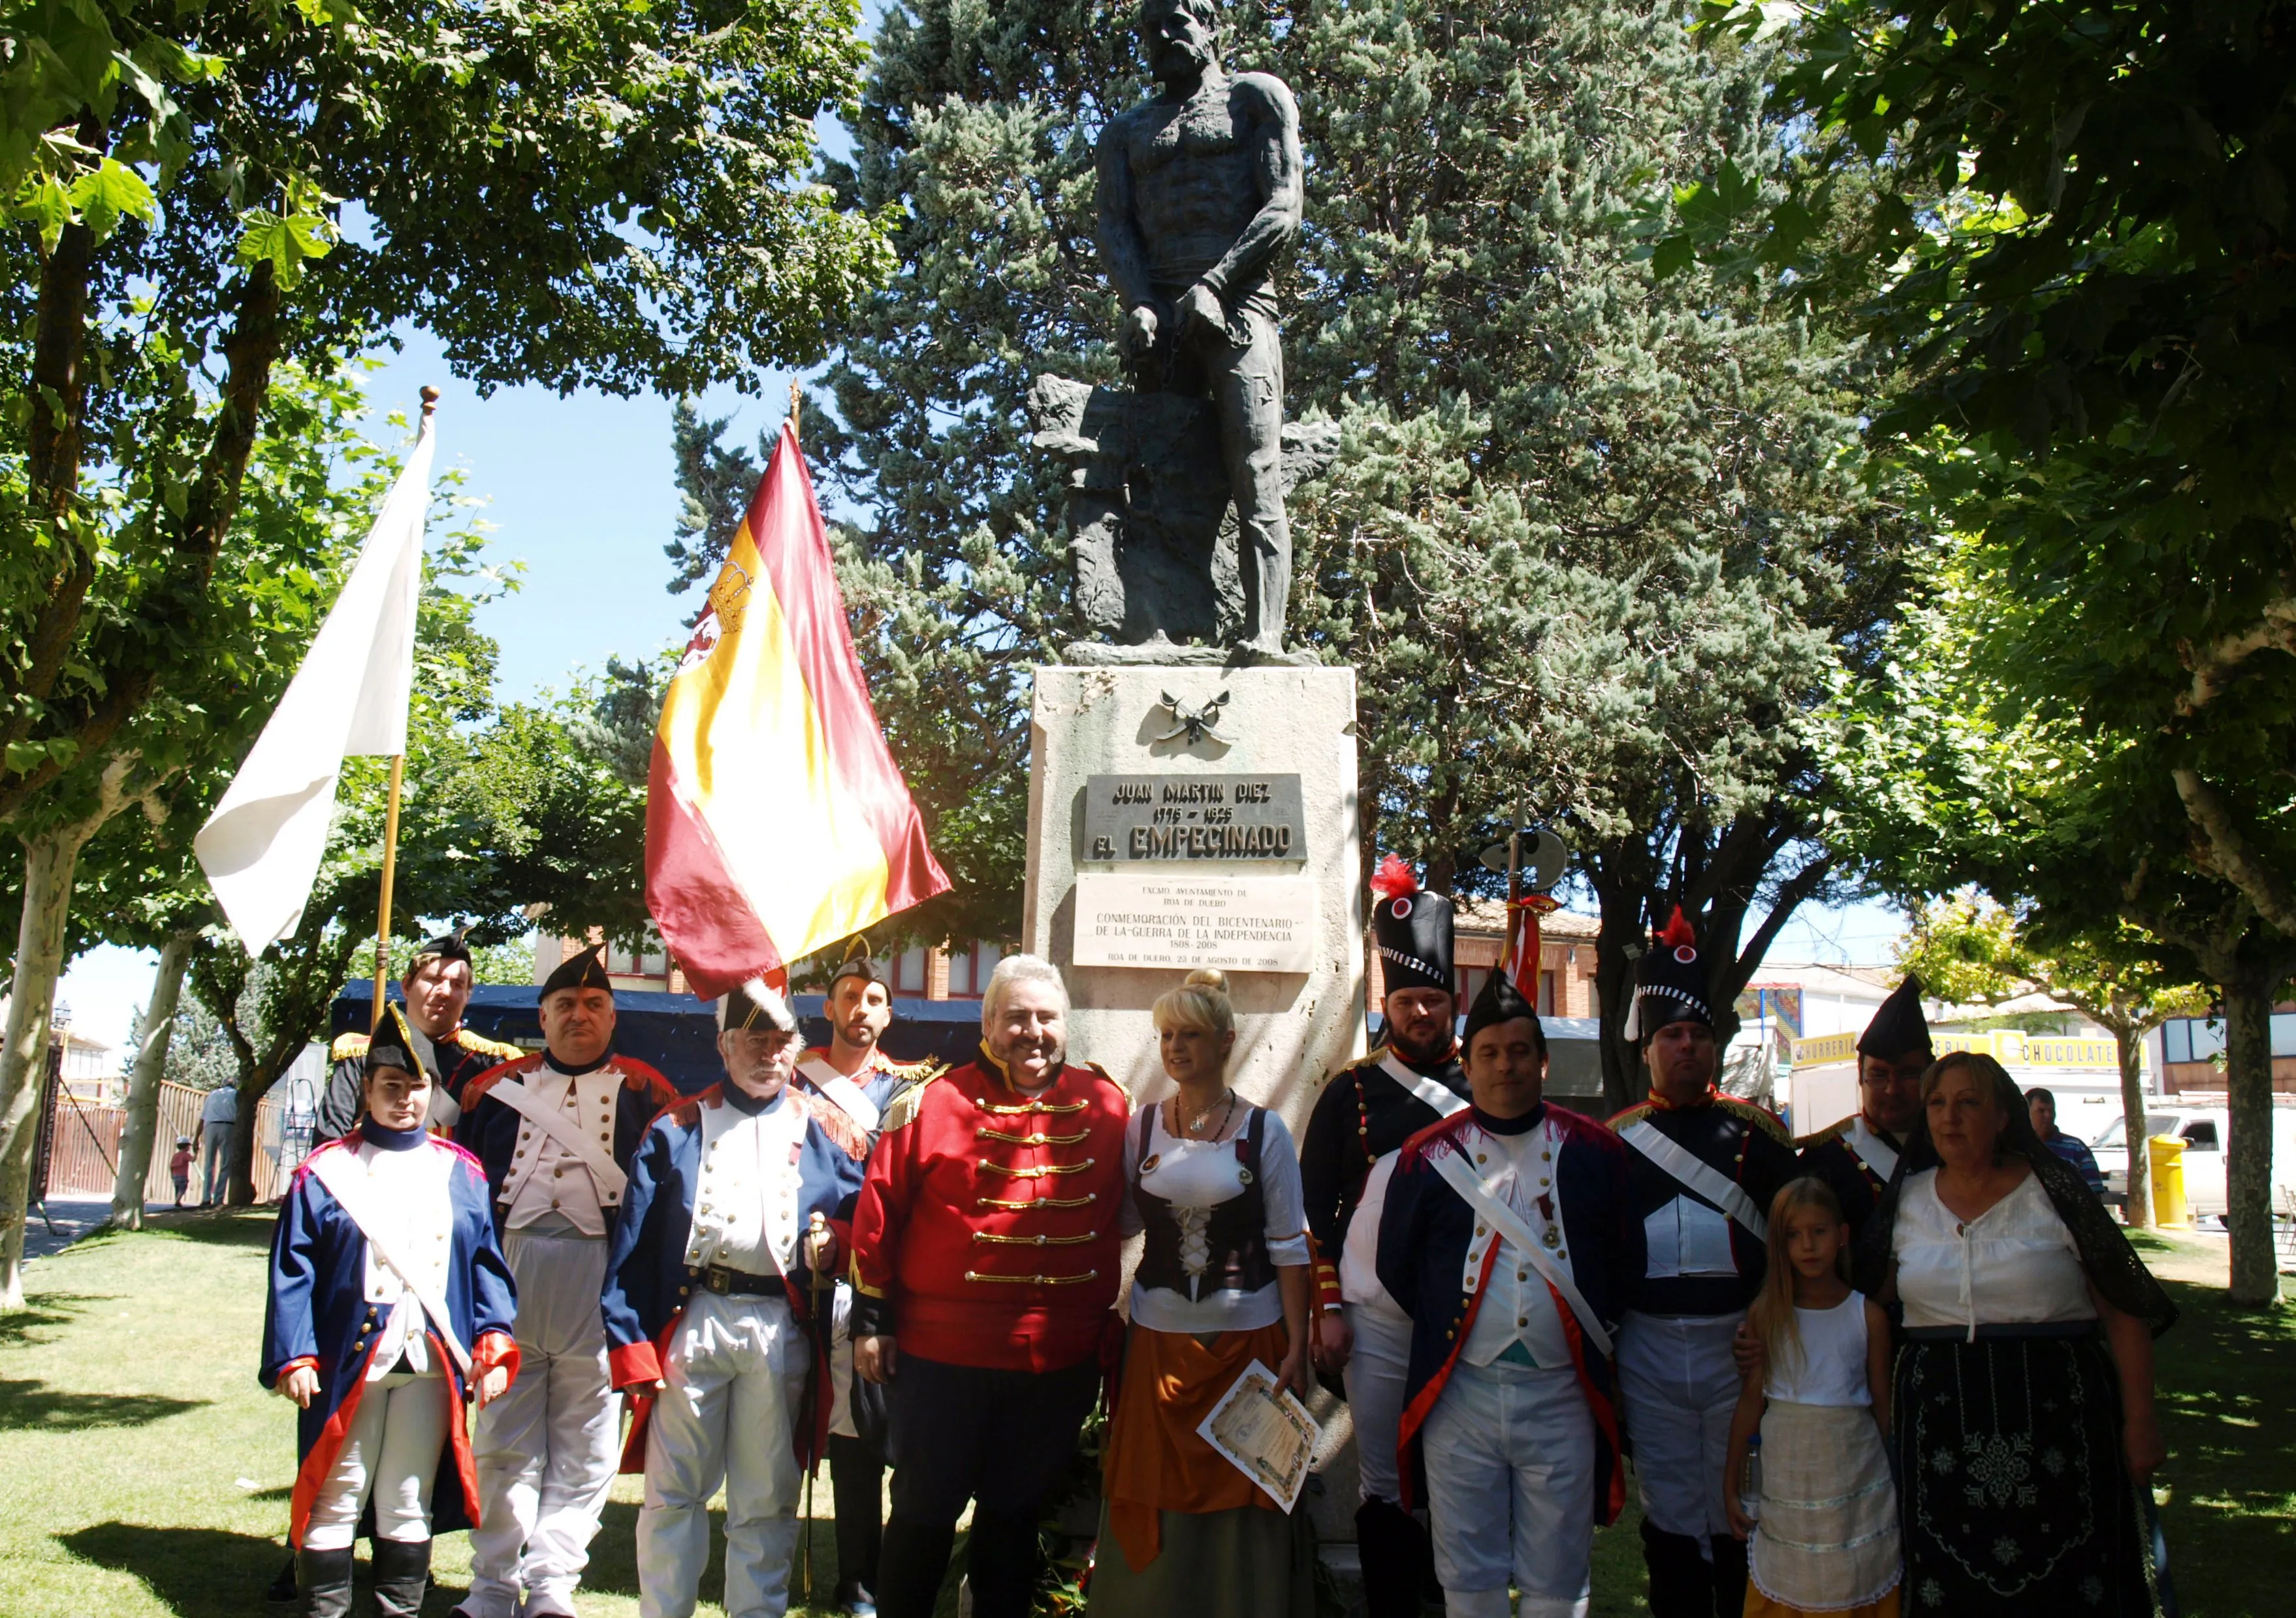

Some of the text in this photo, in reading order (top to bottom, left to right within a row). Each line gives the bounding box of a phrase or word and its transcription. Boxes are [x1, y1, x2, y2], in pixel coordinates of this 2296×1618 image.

[1115, 783, 1273, 799] JUAN MARTIN DIEZ
[1156, 806, 1183, 818] 1775
[1206, 806, 1234, 819] 1825
[1096, 824, 1293, 853] EL EMPECINADO
[1175, 887, 1233, 897] AYUNTAMIENTO
[1164, 898, 1179, 906] ROA
[1096, 912, 1293, 929] CONMEMORACIÓN DEL BICENTENARIO
[1096, 925, 1108, 936] DE
[1177, 928, 1191, 938] DE
[1196, 928, 1209, 939] LA
[1214, 929, 1292, 942] INDEPENDENCIA
[1108, 953, 1124, 961] ROA
[1207, 956, 1238, 964] AGOSTO
[1257, 958, 1279, 966] 2008
[1799, 1038, 1855, 1060] CHURRERIA
[2022, 1044, 2114, 1062] CHOCOLATE
